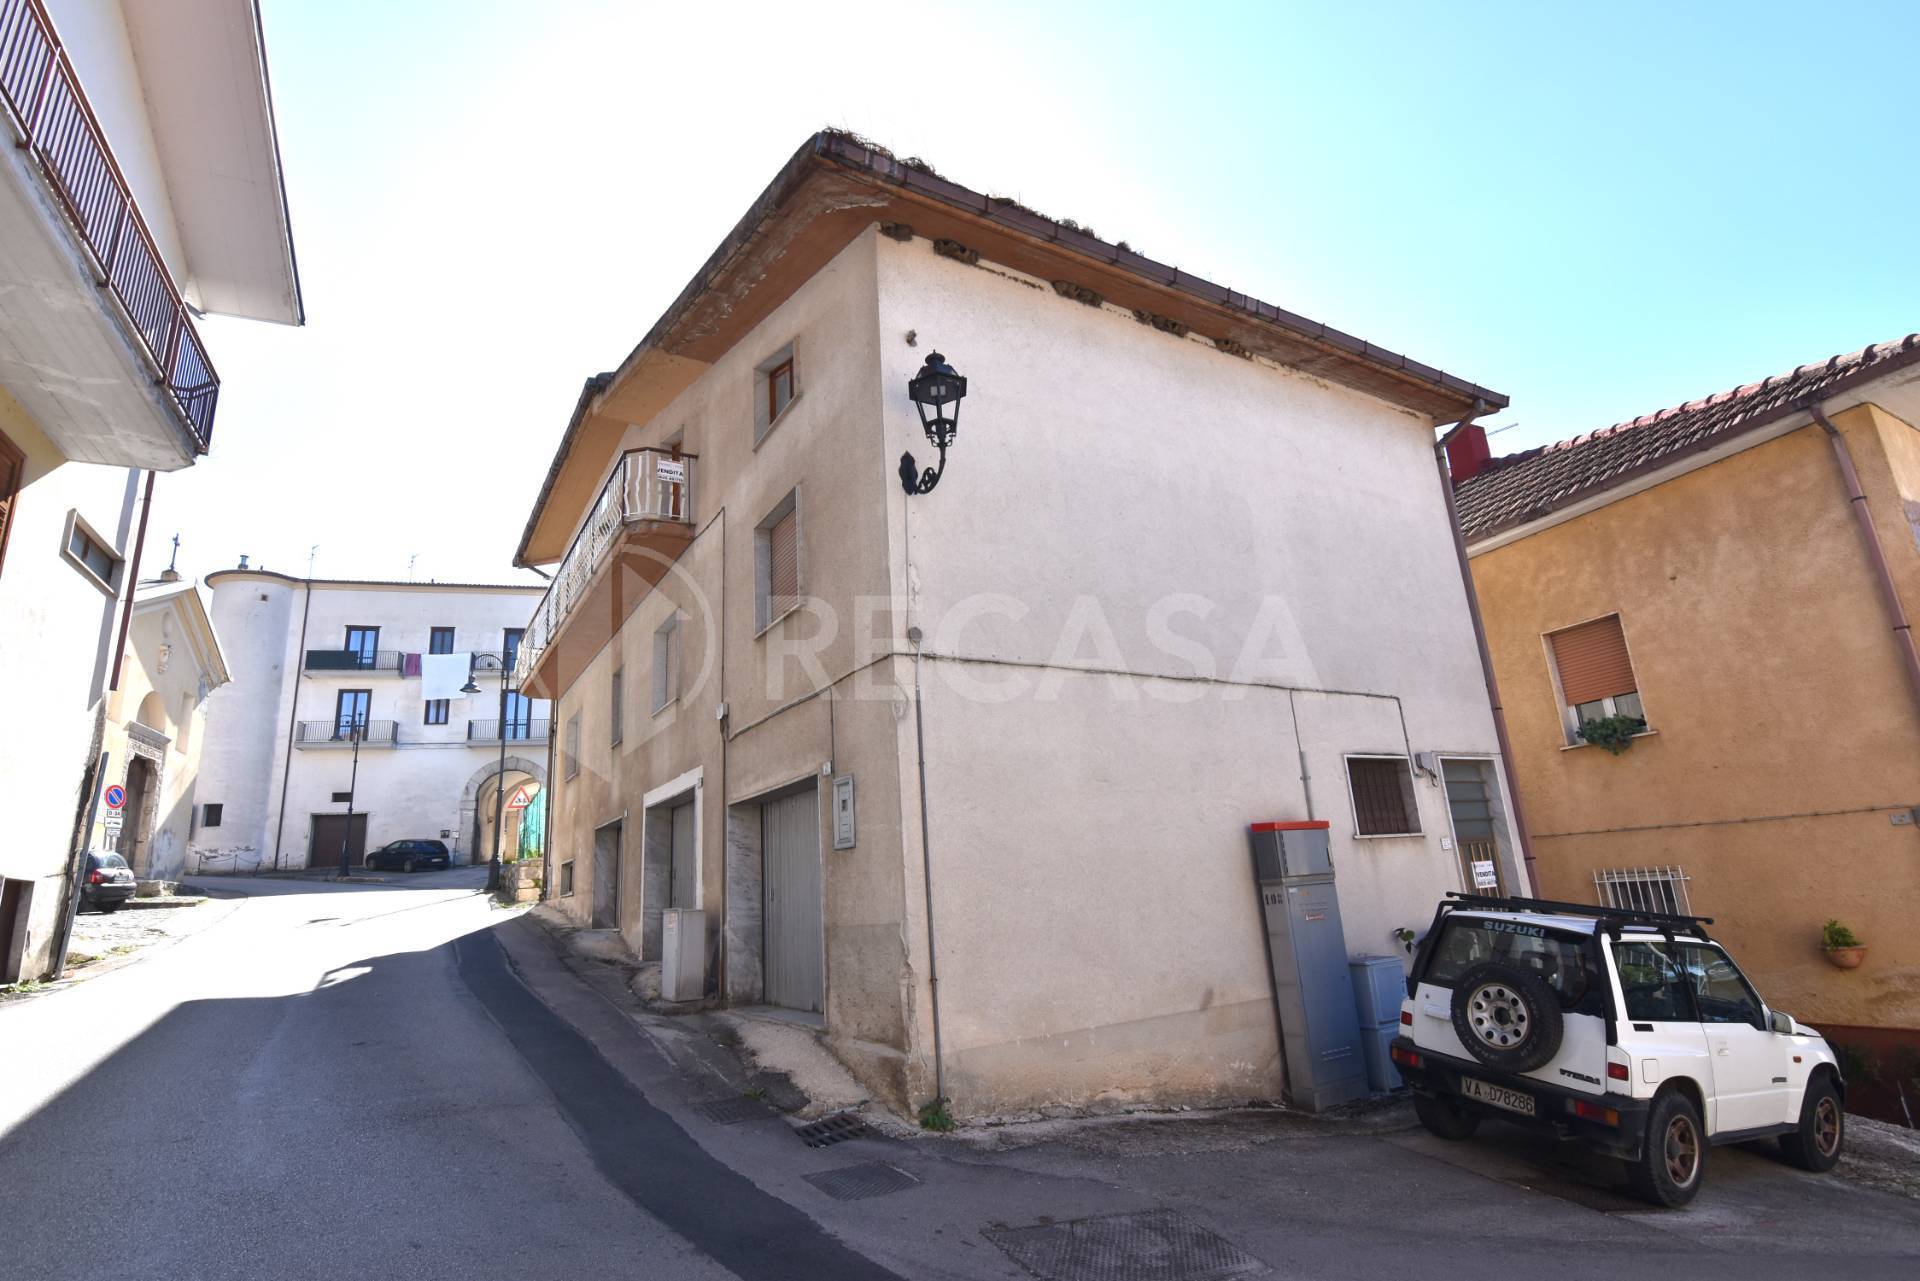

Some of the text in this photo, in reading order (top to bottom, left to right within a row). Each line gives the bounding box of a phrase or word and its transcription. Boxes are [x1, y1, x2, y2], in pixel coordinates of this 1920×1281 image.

[657, 468, 684, 477] VENDITA
[1483, 921, 1545, 938] SUZUKI
[1465, 1079, 1534, 1113] VA D78286
